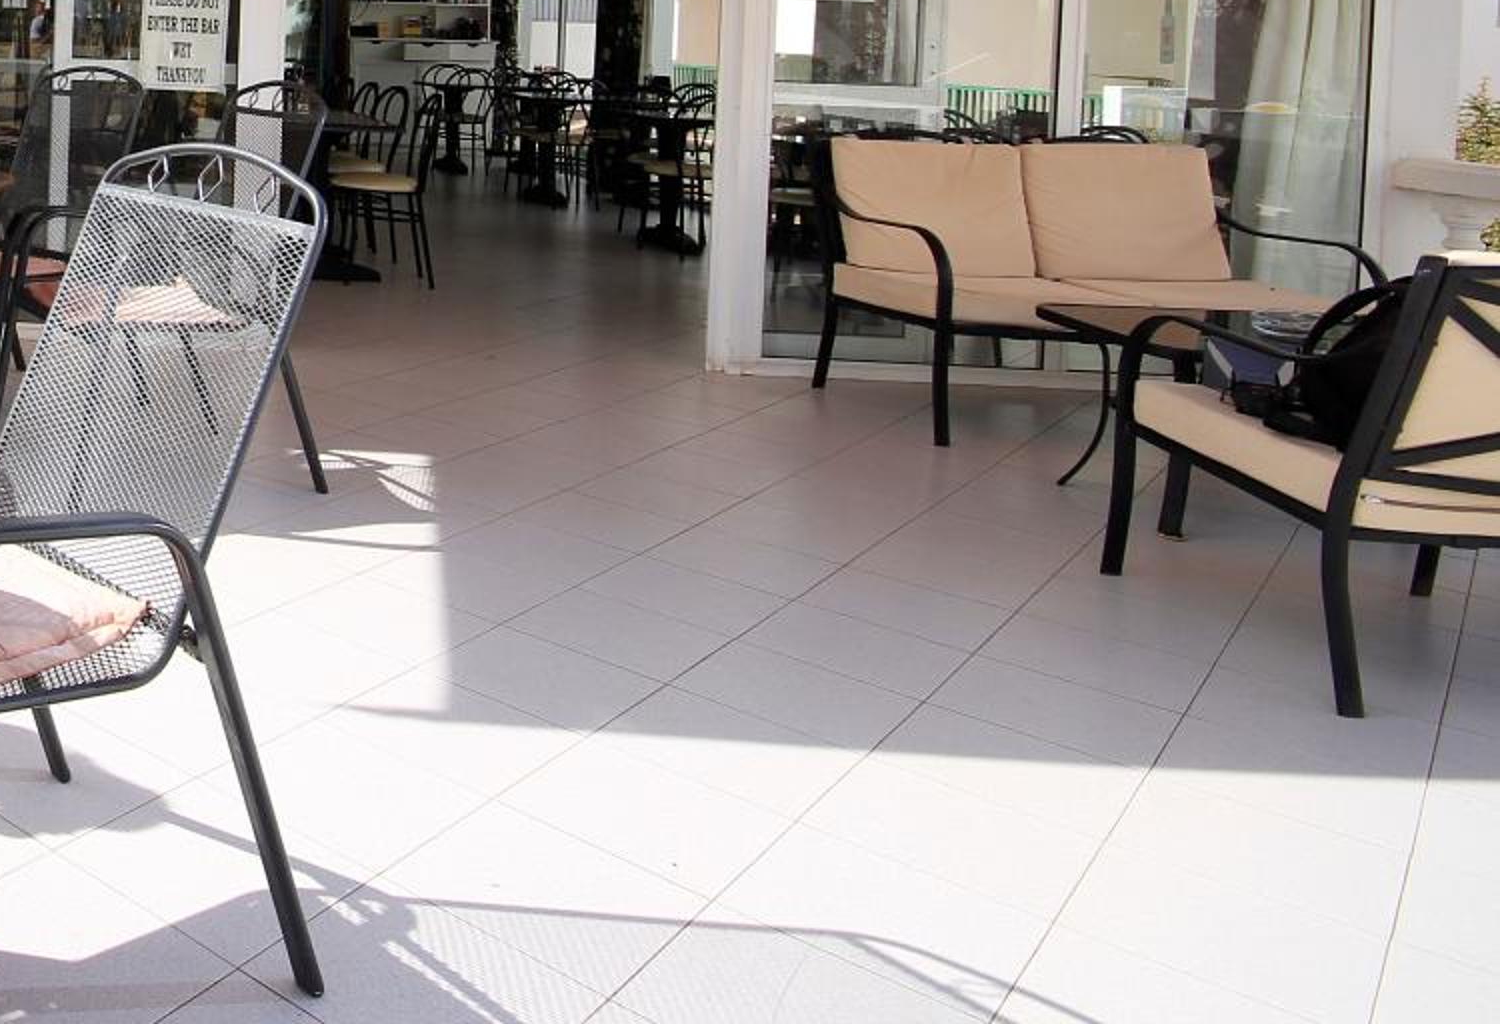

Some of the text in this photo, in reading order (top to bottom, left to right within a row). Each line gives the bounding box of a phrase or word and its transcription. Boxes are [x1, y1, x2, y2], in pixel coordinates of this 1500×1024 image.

[147, 15, 220, 34] ENTER THE BAR
